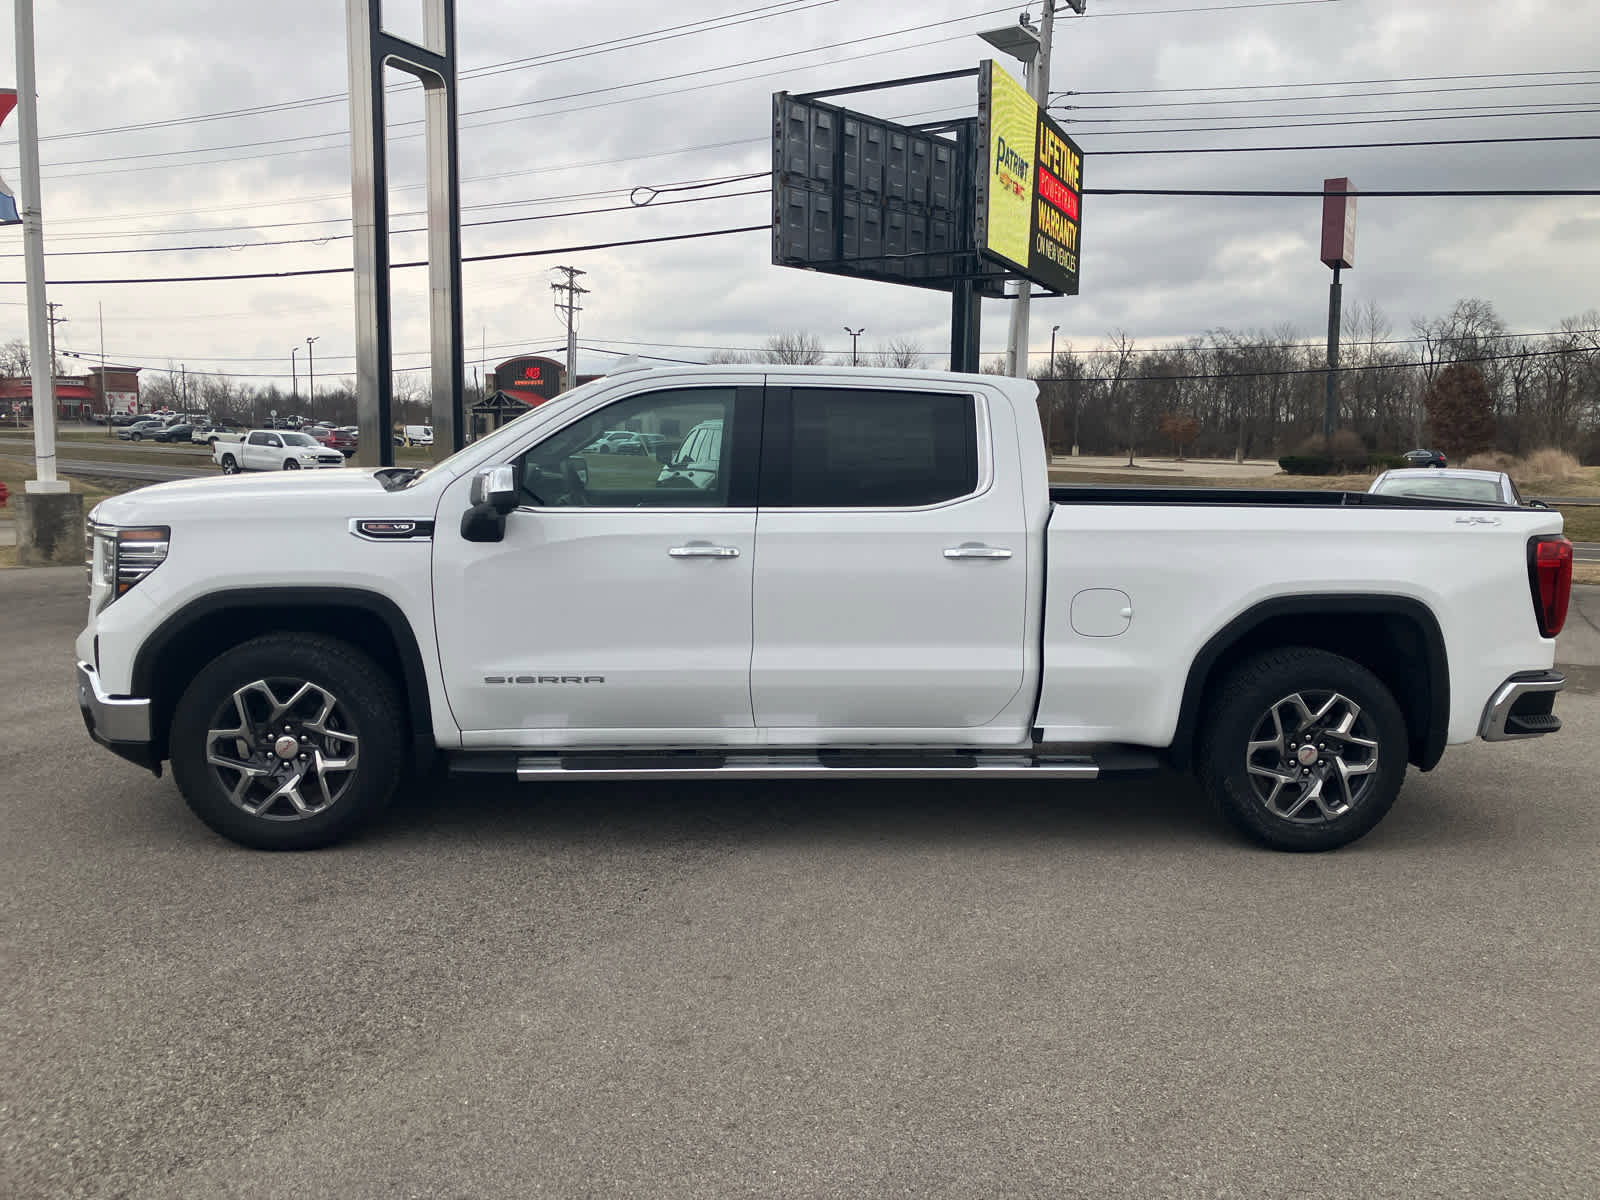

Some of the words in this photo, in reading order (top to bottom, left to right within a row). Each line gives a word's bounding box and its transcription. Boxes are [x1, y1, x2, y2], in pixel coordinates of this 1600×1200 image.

[995, 135, 1029, 184] PATRIOT
[1040, 121, 1080, 193] LIFETIME
[1037, 233, 1045, 256] ON
[1038, 199, 1077, 252] WARRANTY
[484, 676, 606, 684] SIERRA
